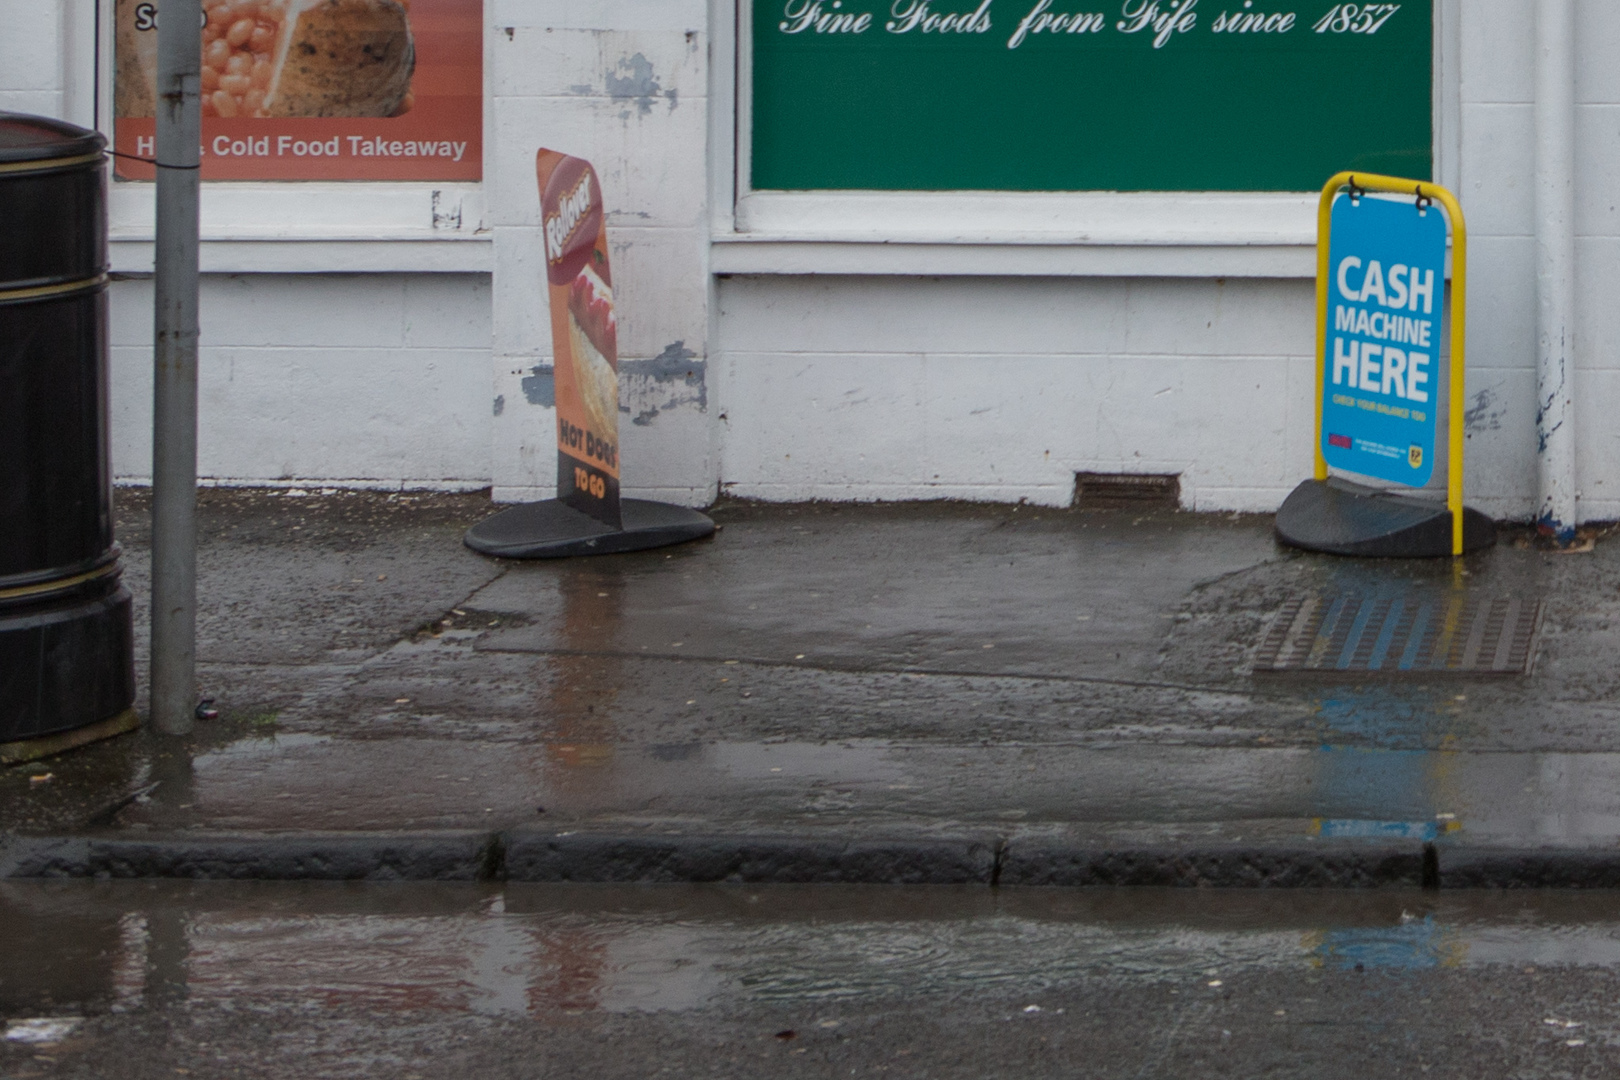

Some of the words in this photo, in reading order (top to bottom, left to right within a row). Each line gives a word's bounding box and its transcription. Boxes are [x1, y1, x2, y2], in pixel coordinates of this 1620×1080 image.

[1212, 0, 1296, 34] since
[1311, 3, 1401, 33] 1857
[212, 136, 269, 156] Cold
[277, 136, 339, 156] Food
[347, 136, 467, 161] Takeaway
[547, 172, 590, 260] Rollover
[1337, 255, 1434, 314] CASH
[1335, 305, 1431, 347] MACHINE
[1332, 337, 1430, 403] HERE
[561, 418, 583, 451] HOT
[586, 430, 615, 468] DOGS
[575, 467, 588, 491] TO
[590, 474, 605, 499] GO
